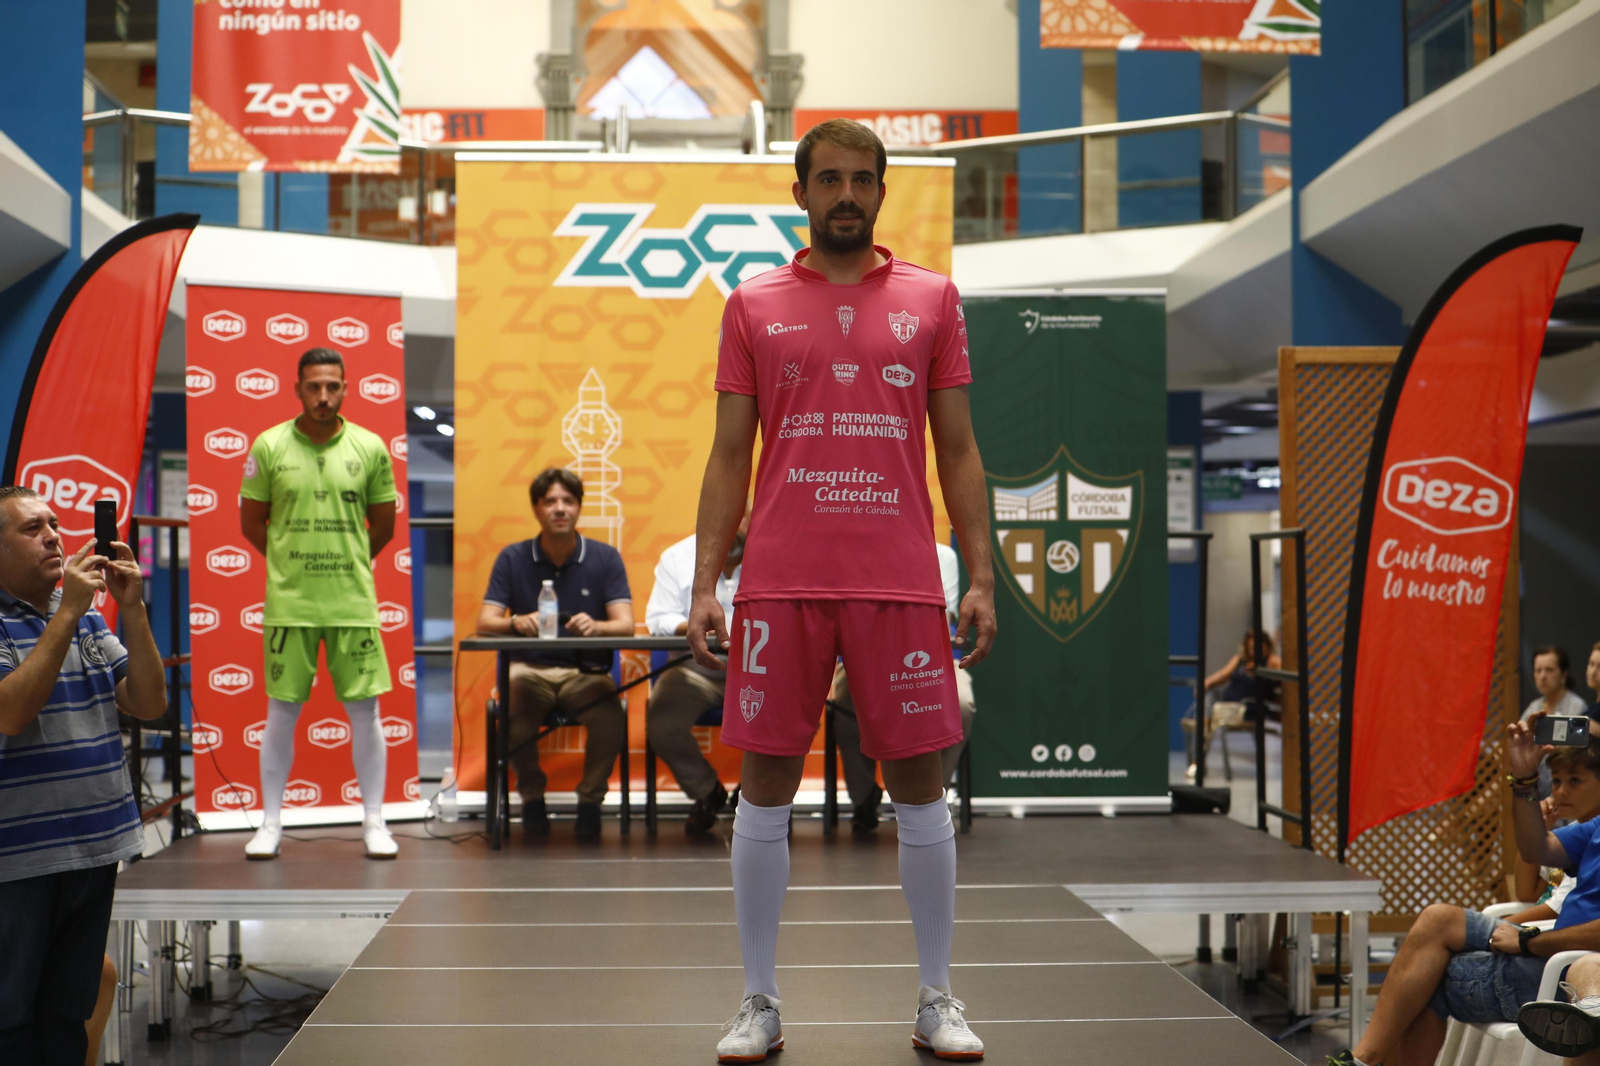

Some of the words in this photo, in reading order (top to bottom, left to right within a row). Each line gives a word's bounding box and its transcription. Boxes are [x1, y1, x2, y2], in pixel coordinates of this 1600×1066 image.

[219, 10, 301, 35] ningún
[306, 10, 361, 31] sitio
[832, 364, 859, 372] OUTER
[835, 371, 855, 379] RING
[186, 374, 211, 389] eza
[832, 412, 901, 427] PATRIMONIO
[778, 427, 824, 438] CÓRDOBA
[832, 424, 908, 440] HUMANIDAD
[786, 467, 885, 486] Mezquita-
[187, 492, 213, 507] eza
[815, 486, 899, 504] Catedral
[1071, 491, 1126, 504] CÓRDOBA
[814, 504, 851, 513] Corazón
[853, 505, 863, 513] de
[865, 505, 900, 516] Córdoba
[1077, 505, 1121, 516] FUTSAL
[1377, 538, 1491, 579] Cuidamos
[1383, 571, 1403, 600] lo
[1407, 579, 1486, 607] nuestro
[189, 611, 215, 625] eza
[379, 610, 404, 623] eza
[742, 618, 770, 675] 12
[890, 673, 898, 682] El
[900, 666, 945, 681] Arcángel
[890, 683, 914, 691] CENTRO
[192, 731, 218, 745] eza
[999, 767, 1129, 779] www.cordobafutsal.com
